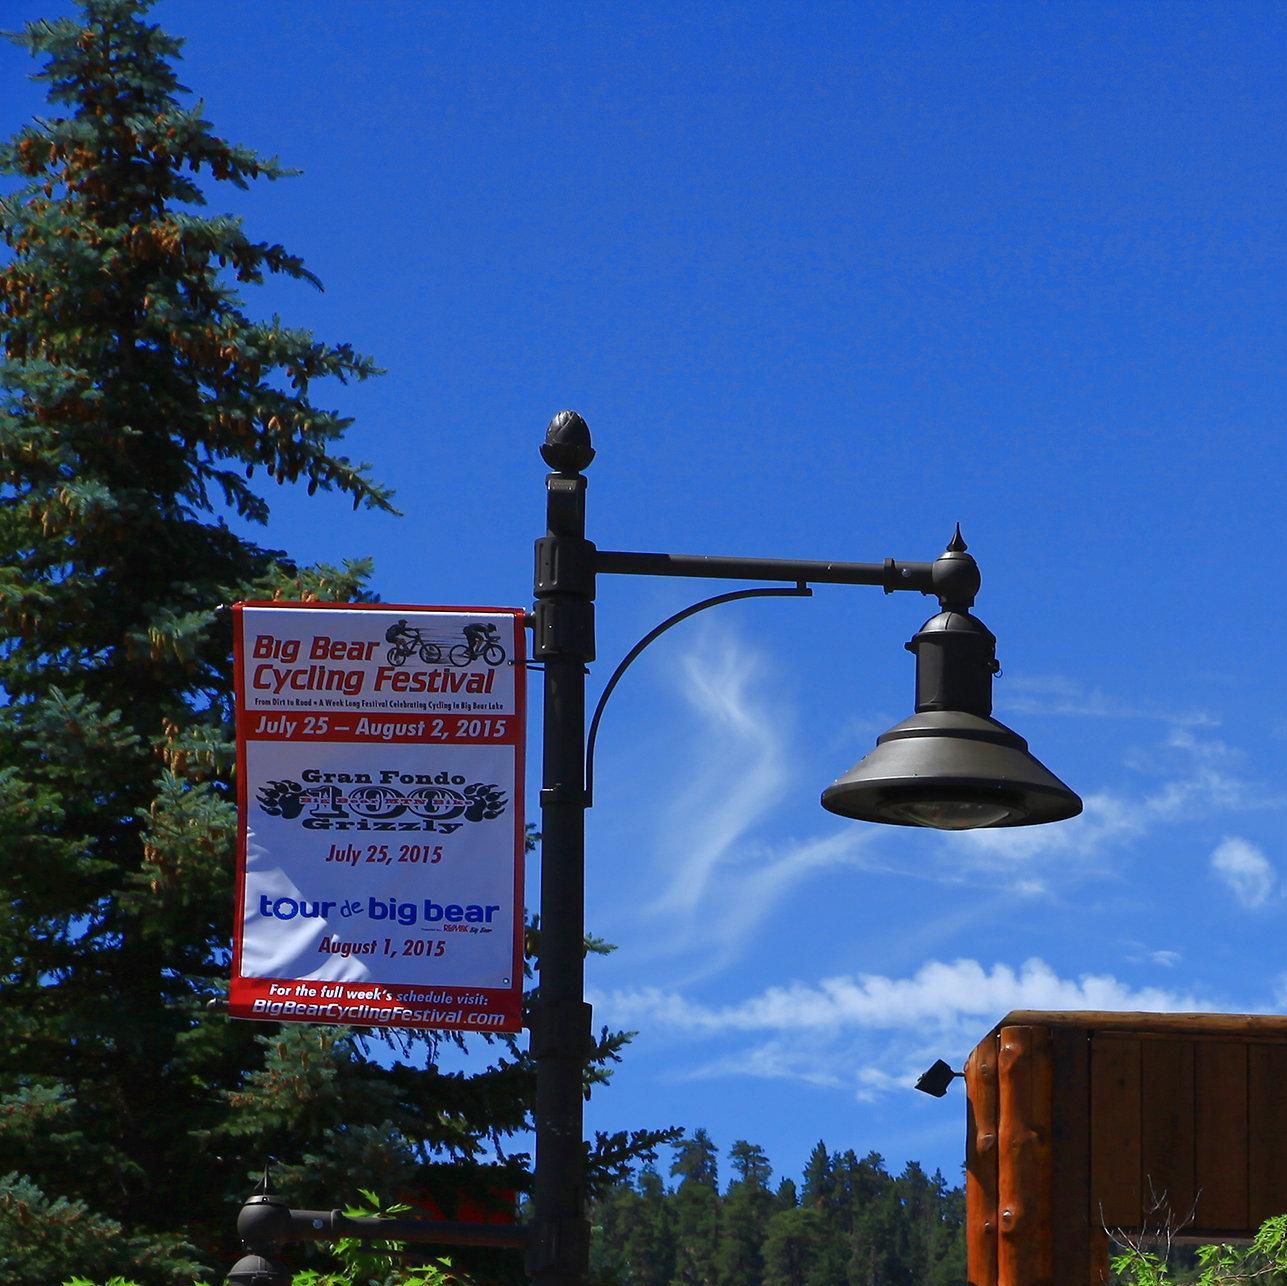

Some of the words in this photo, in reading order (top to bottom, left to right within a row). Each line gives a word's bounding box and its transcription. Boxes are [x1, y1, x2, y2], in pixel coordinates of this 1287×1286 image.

[253, 635, 300, 663] Big
[309, 636, 380, 661] Bear
[253, 664, 364, 695] Cycling
[374, 666, 495, 694] Festival
[254, 698, 271, 706] From
[272, 698, 286, 706] Dirt
[325, 699, 344, 707] Week
[345, 700, 361, 709] Long
[361, 700, 388, 708] Festival
[389, 701, 427, 710] Celebrating
[428, 701, 452, 711] Cycling
[461, 702, 472, 711] Big
[473, 702, 487, 710] Bear
[488, 702, 504, 710] Lake
[255, 715, 298, 738] July
[302, 716, 328, 735] 25
[355, 717, 425, 739] August
[431, 719, 449, 740] 2,
[456, 719, 506, 738] 2015
[301, 769, 373, 784] Gran
[380, 770, 466, 785] Fondo
[301, 818, 464, 835] Grizzly
[325, 844, 362, 866] July
[366, 845, 393, 865] 25,
[398, 845, 443, 864] 2015
[259, 895, 337, 920] tour
[340, 900, 364, 918] de
[368, 897, 418, 925] big
[424, 900, 500, 923] bear
[318, 937, 378, 958] August
[382, 938, 398, 959] 1,
[402, 939, 446, 958] 2015
[269, 983, 292, 996] For
[295, 985, 317, 997] the
[320, 985, 343, 998] full
[346, 988, 393, 1001] week's
[396, 991, 453, 1005] schedule
[457, 993, 488, 1006] visit:
[252, 998, 505, 1026] BigBearCyclingFestival.com
